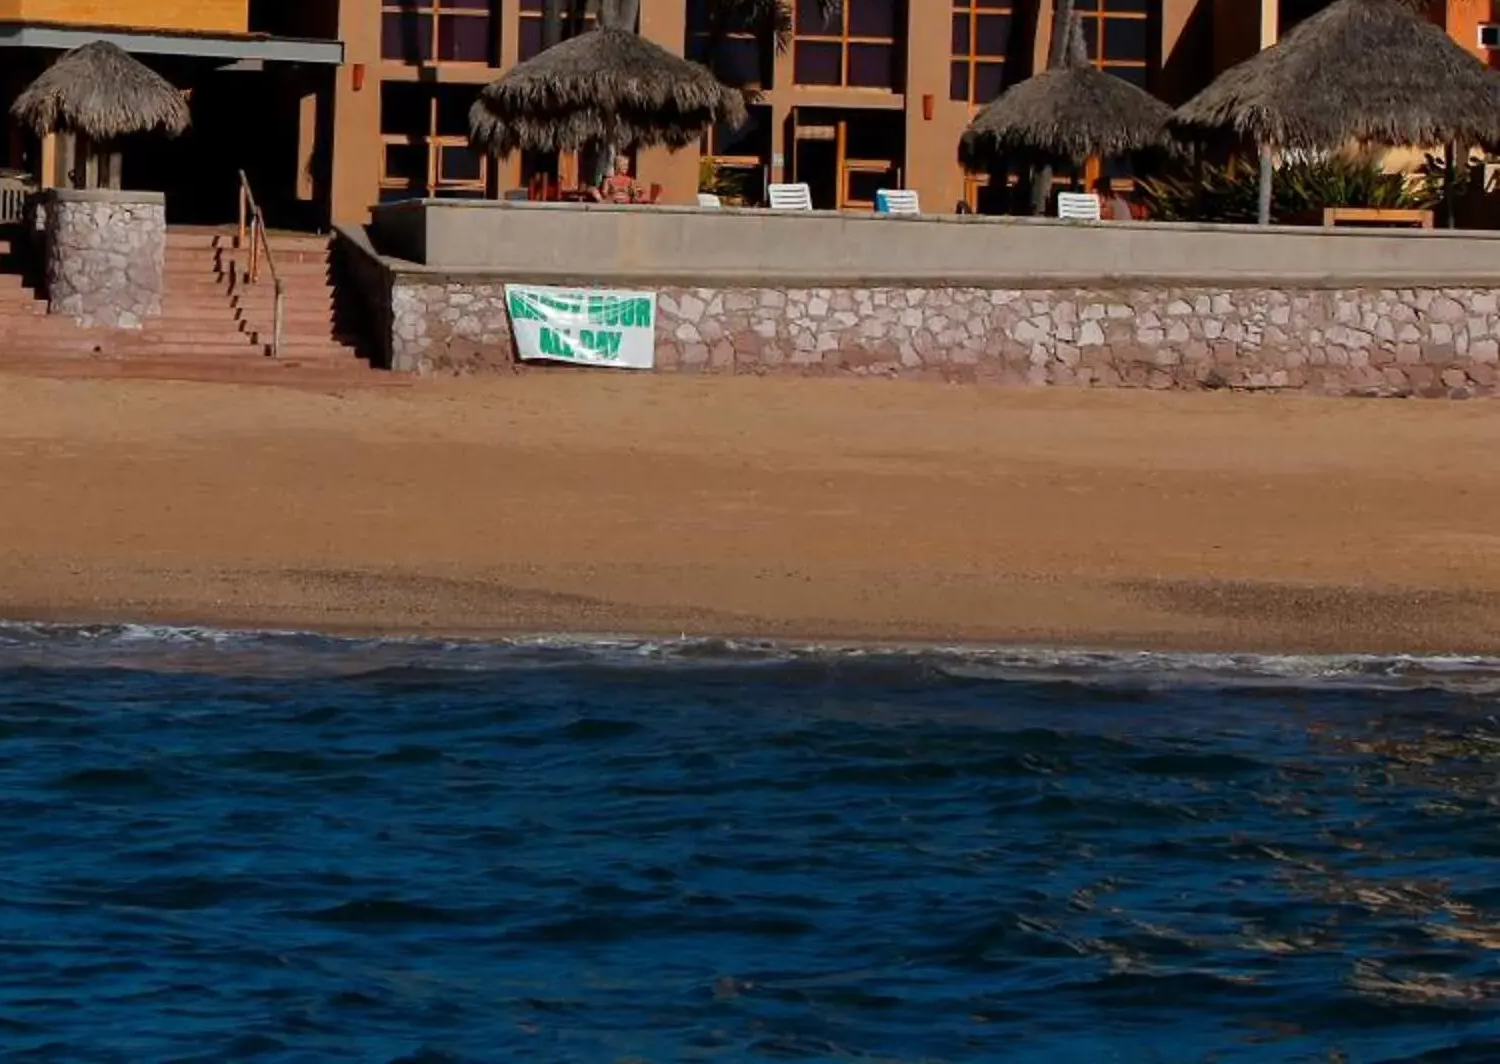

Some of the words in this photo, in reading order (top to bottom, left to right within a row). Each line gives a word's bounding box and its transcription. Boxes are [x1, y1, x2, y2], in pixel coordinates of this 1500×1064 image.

[588, 295, 651, 327] HOUR
[540, 327, 574, 357] ALL
[579, 330, 622, 360] DAY
